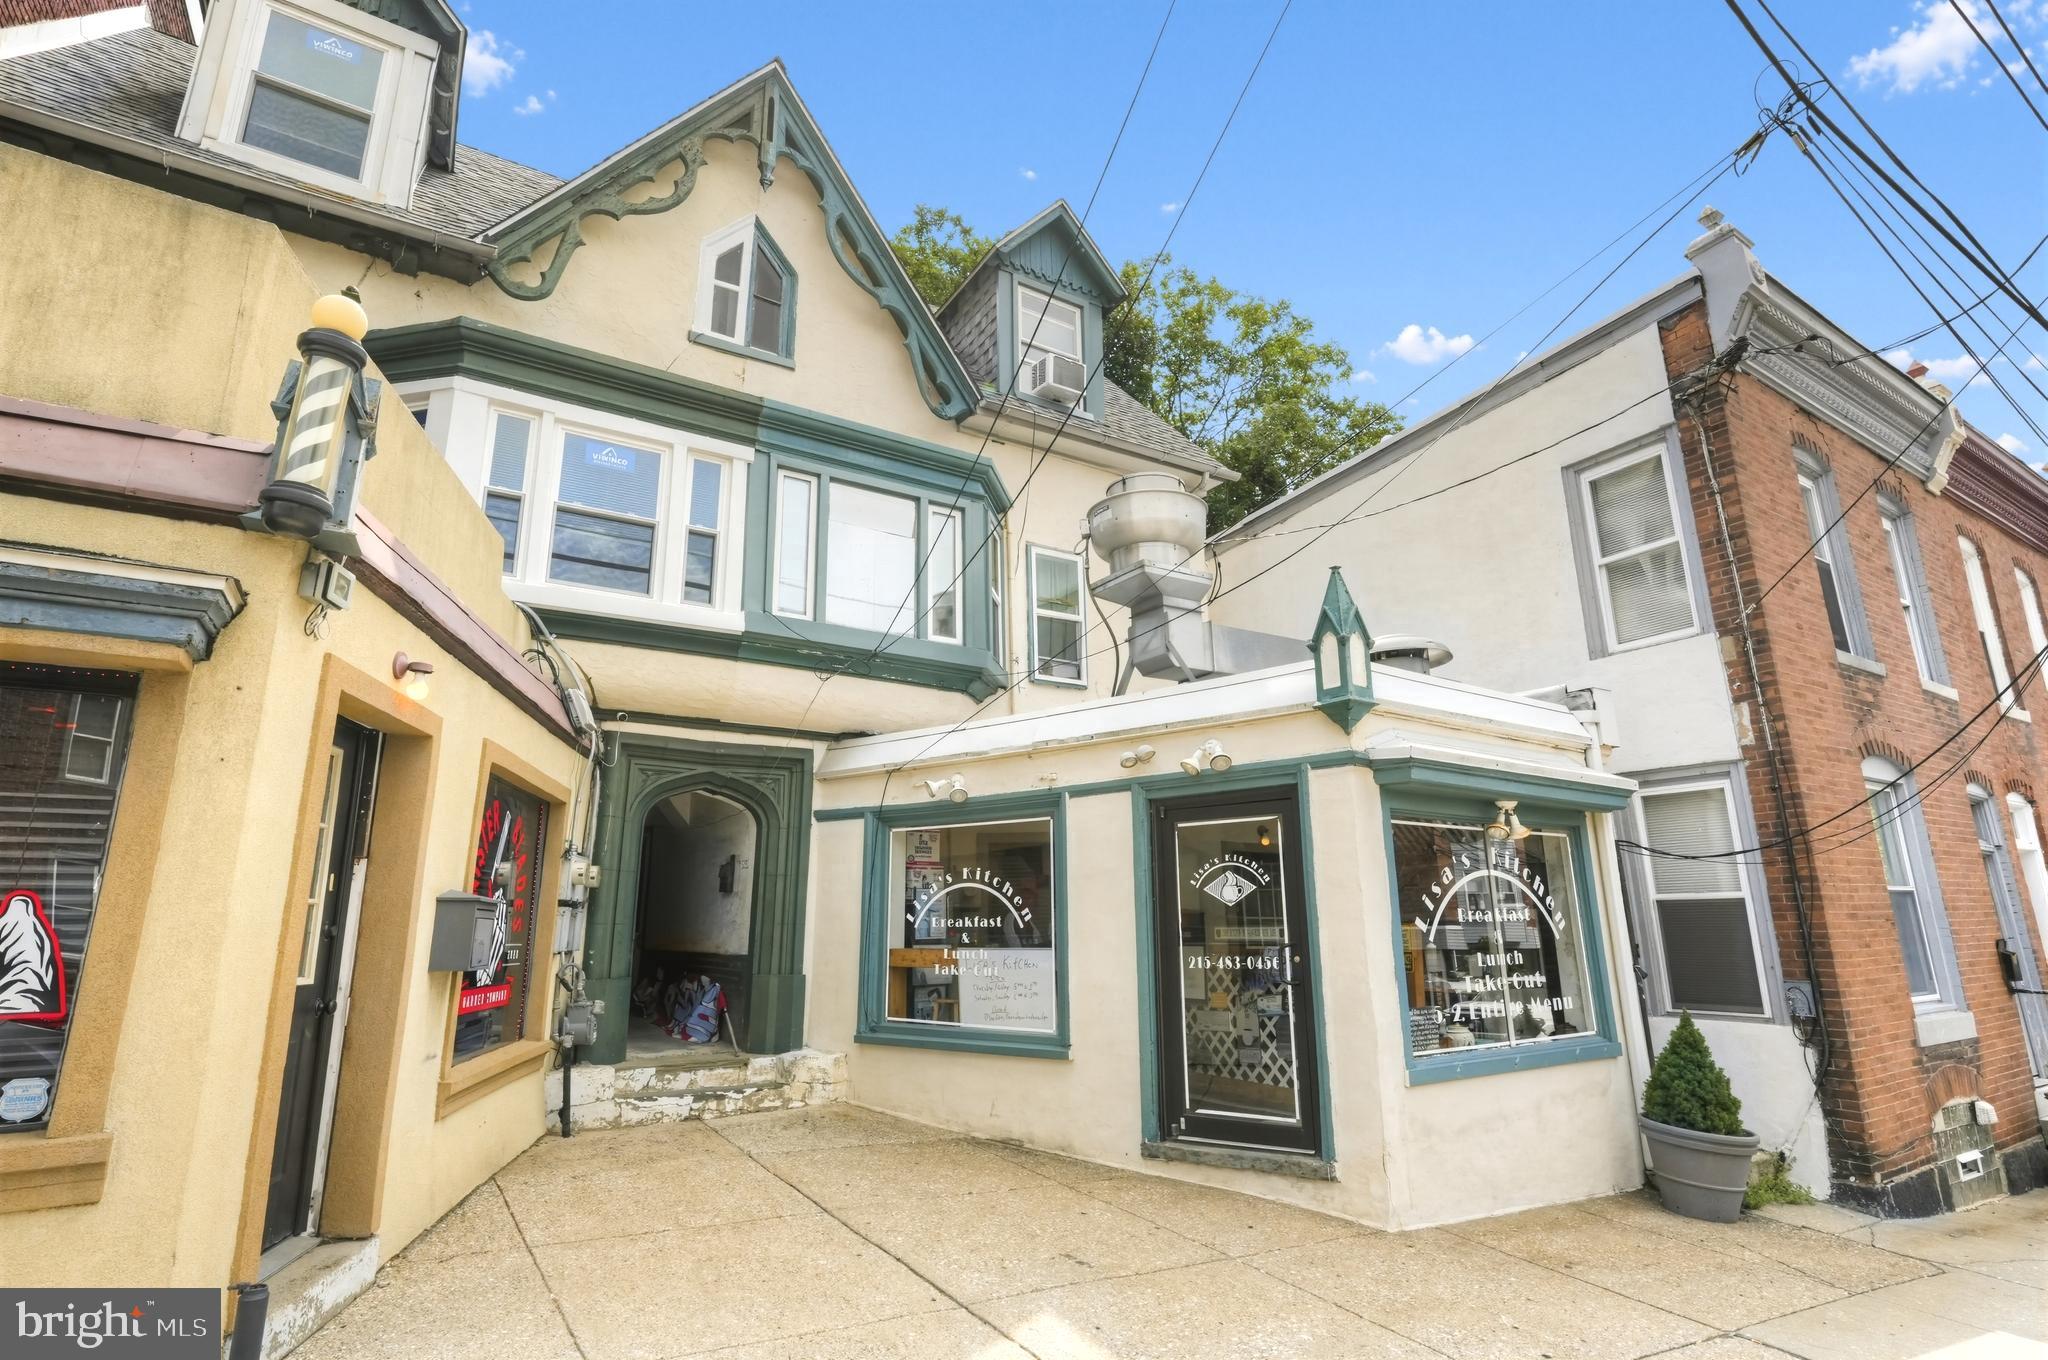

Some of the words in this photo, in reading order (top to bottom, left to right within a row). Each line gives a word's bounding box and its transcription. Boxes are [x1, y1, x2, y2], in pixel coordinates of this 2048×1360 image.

[1190, 857, 1220, 886] Lisa's
[1225, 854, 1271, 883] Kitchen
[905, 872, 953, 924] Lisa's
[963, 867, 1033, 922] Kitchen
[1414, 852, 1471, 934] Lisa's
[1491, 848, 1566, 931] Kitchen
[932, 915, 1002, 928] Breakfast
[1457, 907, 1531, 923] Breakfast
[961, 932, 971, 944] &
[943, 948, 988, 960] Lunch
[1476, 950, 1524, 967] Lunch
[934, 964, 1000, 977] Take-Out
[1463, 971, 1543, 993] Take-Out
[1469, 1000, 1525, 1020] Entire
[1529, 996, 1573, 1012] Menu
